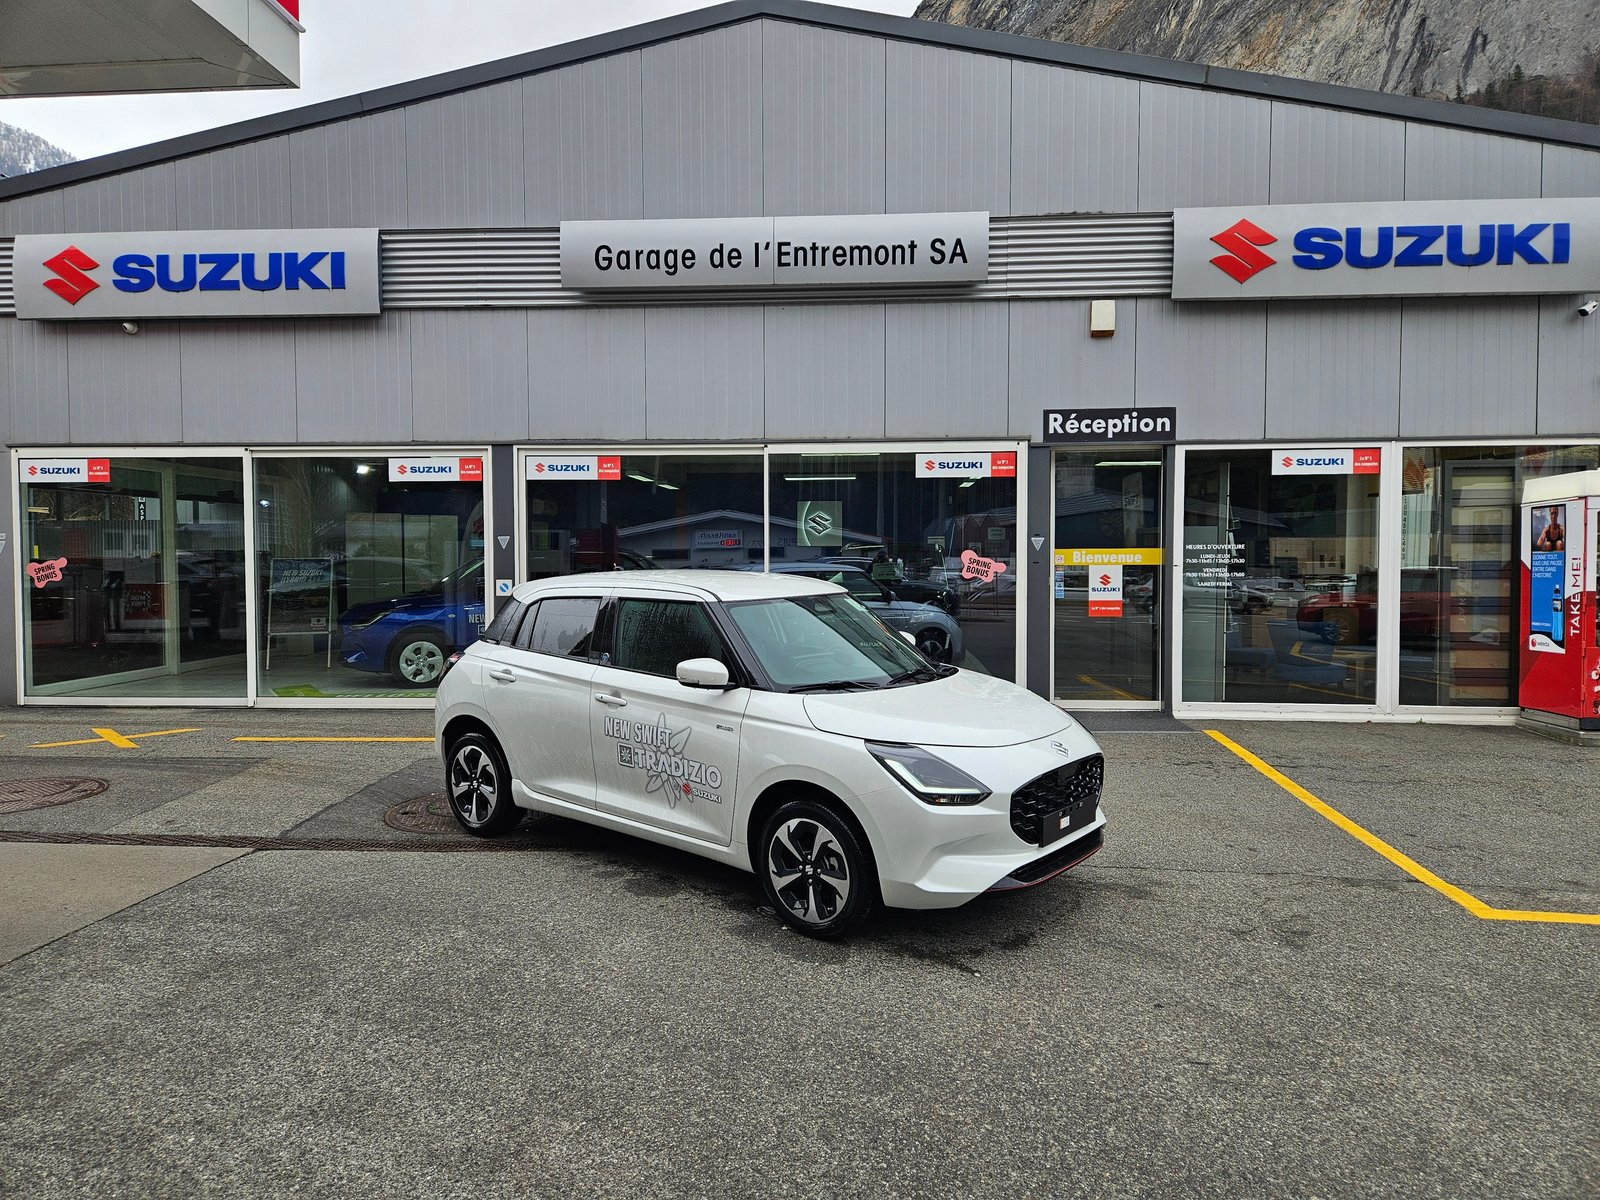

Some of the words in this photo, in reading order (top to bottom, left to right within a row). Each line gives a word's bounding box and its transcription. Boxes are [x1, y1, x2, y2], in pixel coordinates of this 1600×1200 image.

[1292, 222, 1570, 270] SUZUKI
[594, 244, 696, 276] Garage
[709, 243, 743, 269] de
[929, 237, 968, 265] SA
[112, 251, 346, 293] SUZUKI
[1048, 411, 1171, 438] Réception
[547, 464, 590, 472] SUZUKI
[938, 461, 983, 469] SUZUKI
[1296, 458, 1344, 466] SUZUKI
[40, 467, 80, 475] SUZUKI
[410, 466, 452, 474] SUZUKI
[968, 557, 992, 570] SPRING
[1072, 551, 1142, 563] Bienvenue
[33, 563, 56, 576] SPRING
[965, 566, 990, 578] BONUS
[1571, 557, 1581, 587] ME!
[36, 571, 58, 583] BONUS
[1571, 592, 1580, 637] TAKE
[604, 715, 631, 740] NEW
[634, 722, 672, 749] SWIFT
[634, 747, 722, 789] TRADIZIO
[692, 787, 722, 804] SUZUKI
